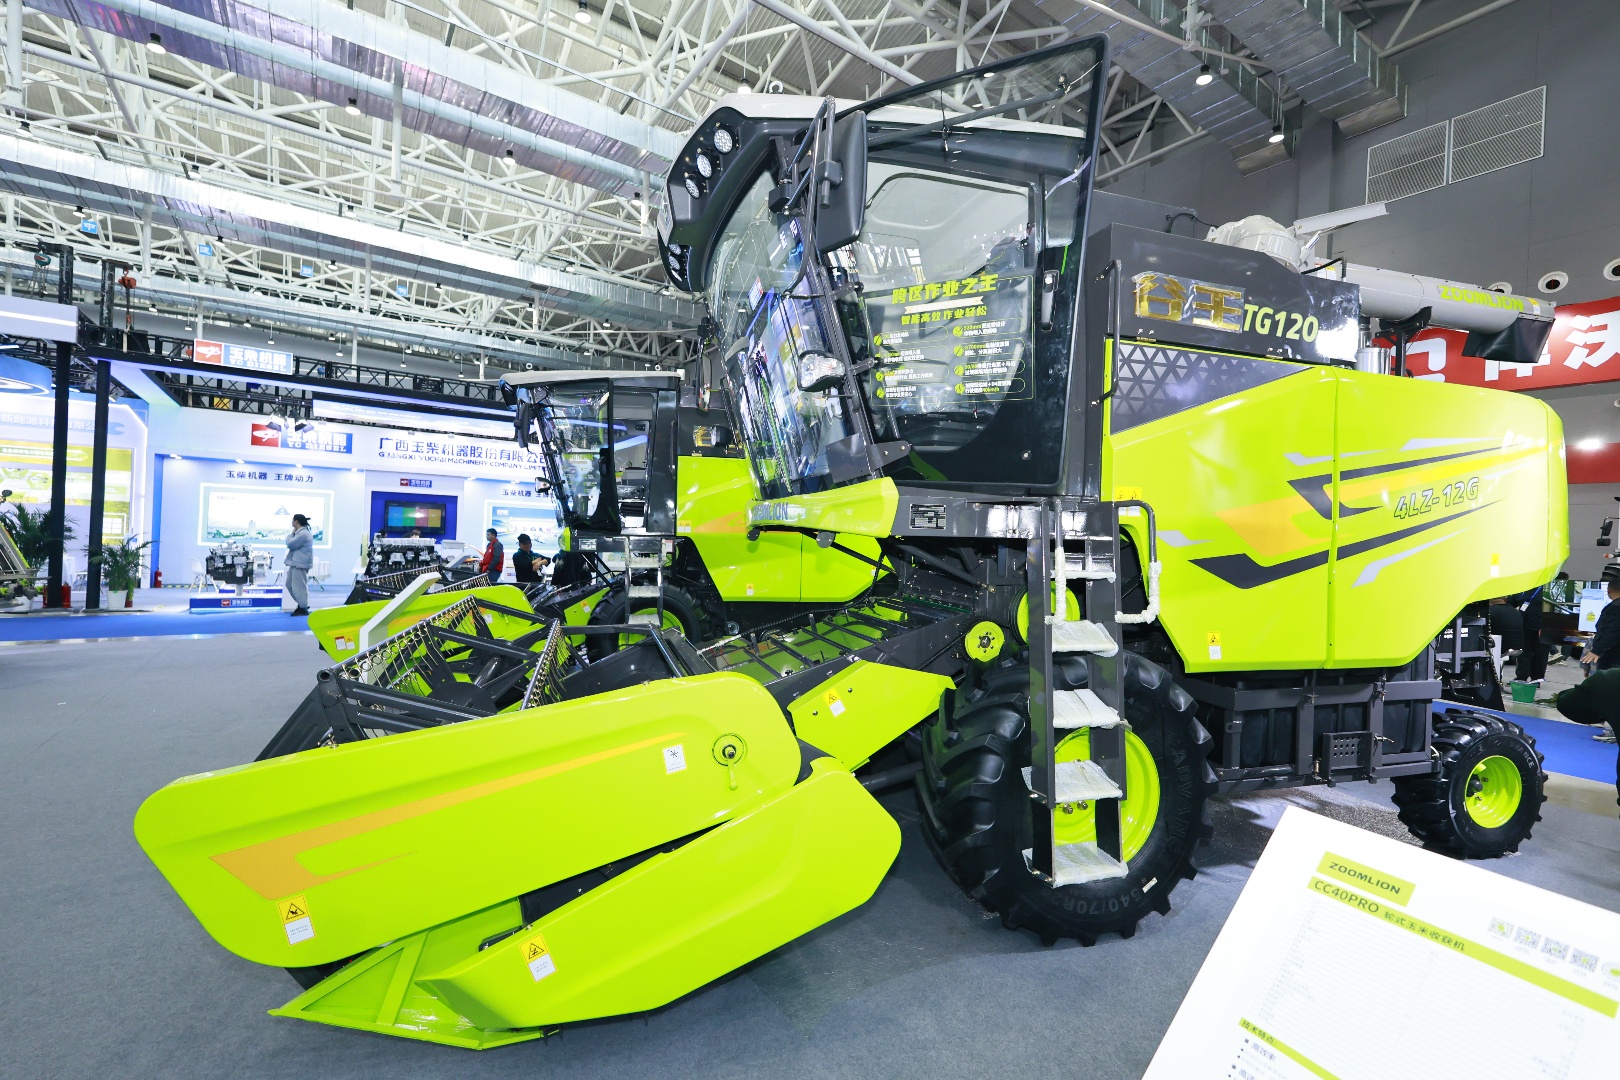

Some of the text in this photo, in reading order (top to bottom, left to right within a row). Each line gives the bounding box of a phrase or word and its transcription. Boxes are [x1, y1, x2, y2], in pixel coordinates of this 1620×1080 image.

[892, 273, 998, 305] 跨区作业之王
[1438, 284, 1524, 311] ZOOMLION
[1133, 274, 1319, 343] 谷王 TG120
[229, 346, 287, 367] 玉柴机器
[1, 413, 96, 431] 新能源科限公
[287, 441, 347, 452] YC DIESEL
[226, 470, 314, 483] 玉柴机器 王牌动力
[1394, 476, 1479, 519] 4LZ-12G
[1329, 861, 1401, 895] ZOOMLION
[1314, 880, 1467, 951] CC40PRO 轮式玉米收获机
